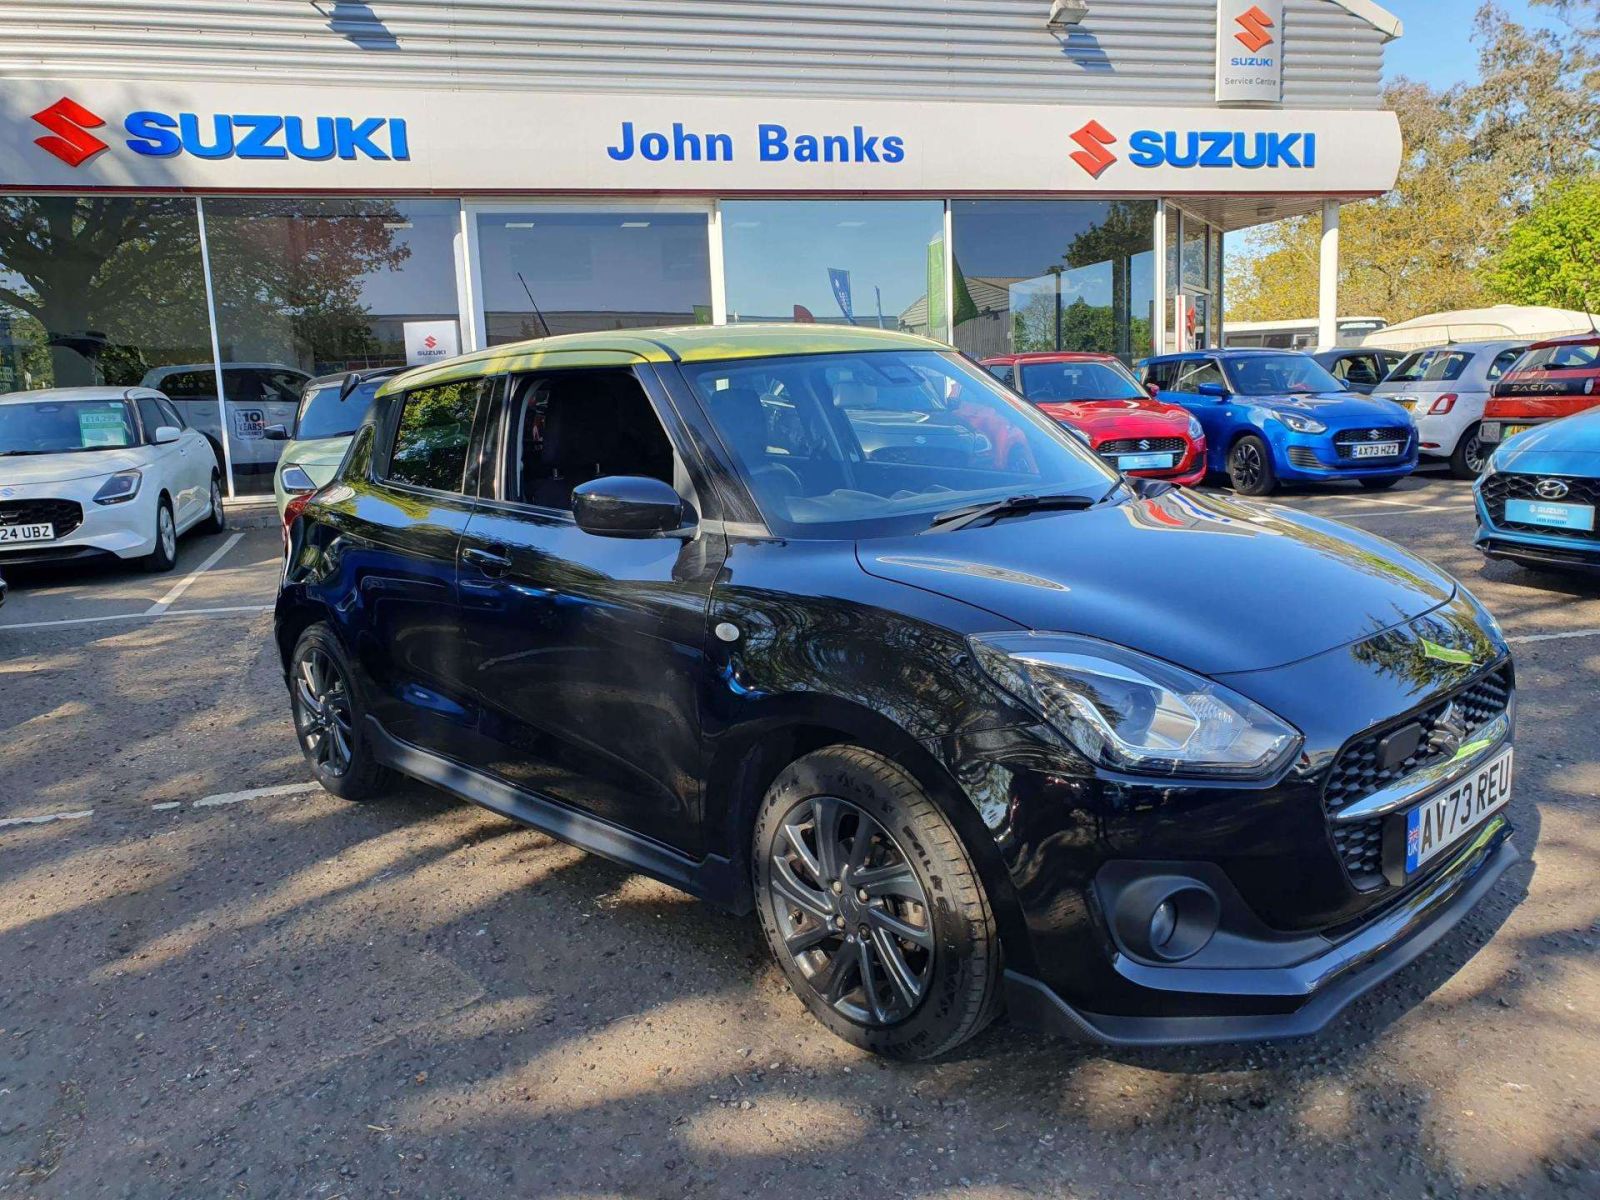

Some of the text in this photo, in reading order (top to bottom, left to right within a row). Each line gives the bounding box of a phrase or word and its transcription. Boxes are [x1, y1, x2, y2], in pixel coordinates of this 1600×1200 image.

[1231, 57, 1273, 67] SUZUKI
[1224, 77, 1277, 86] Service Centre
[124, 111, 409, 160] SUZUKI
[607, 122, 905, 163] John Banks
[1128, 130, 1315, 168] SUZUKI
[242, 412, 261, 422] 10
[1381, 445, 1397, 455] HZZ
[21, 525, 51, 538] UBZ
[1420, 754, 1510, 854] AV73 REU
